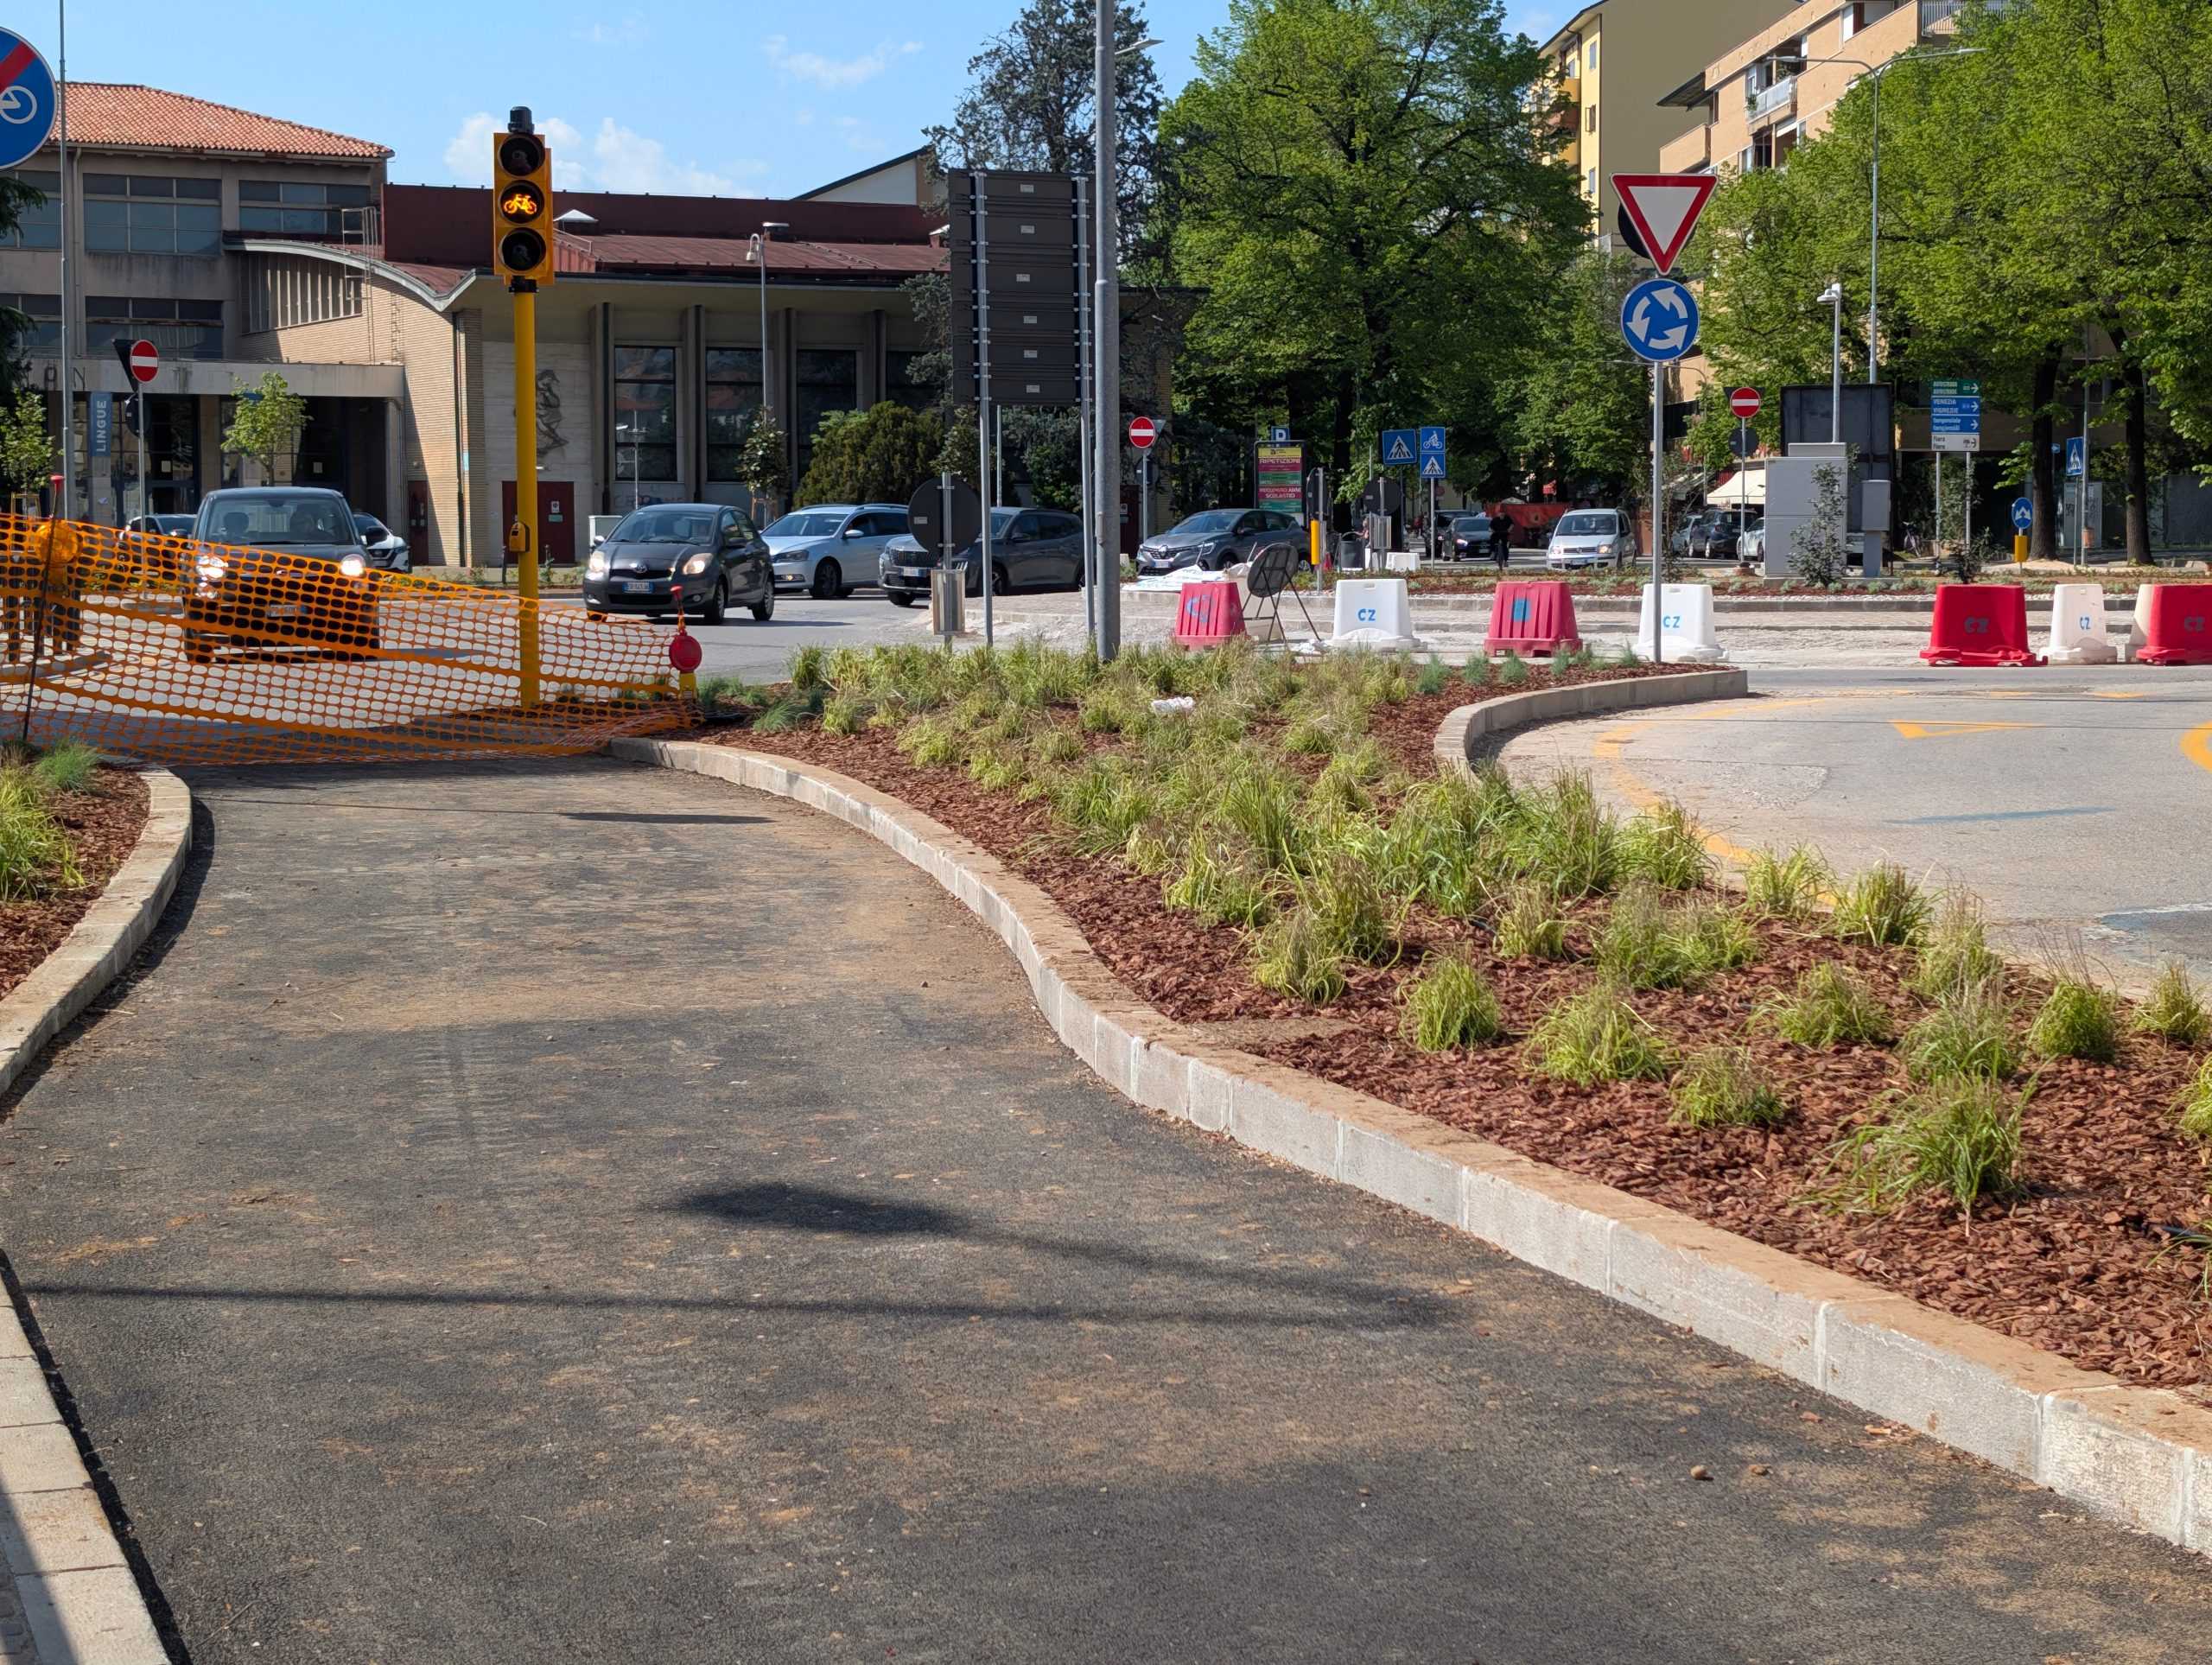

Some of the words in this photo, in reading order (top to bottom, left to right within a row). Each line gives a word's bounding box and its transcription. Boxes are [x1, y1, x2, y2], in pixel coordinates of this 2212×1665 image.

[96, 399, 108, 454] LINGUE
[1357, 607, 1376, 622] CZ
[1662, 614, 1681, 629] CZ
[1963, 616, 1990, 633] CZ
[2079, 616, 2091, 631] CZ
